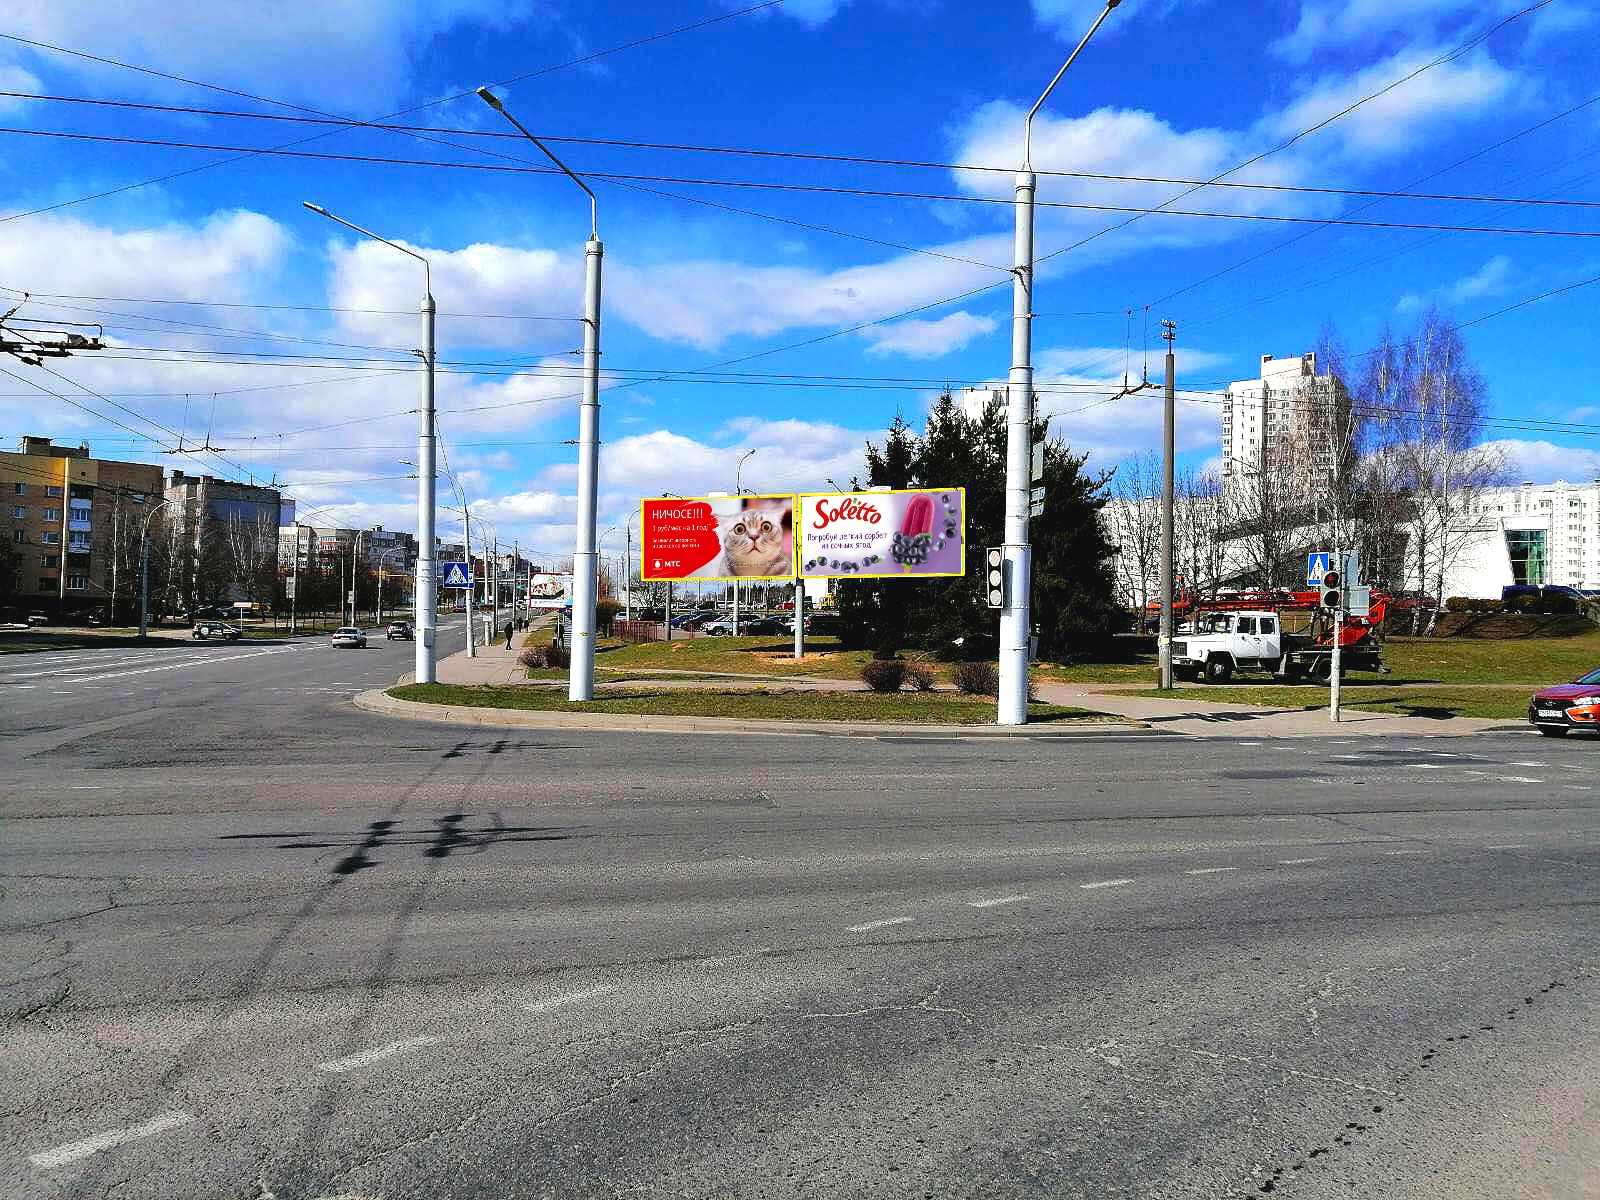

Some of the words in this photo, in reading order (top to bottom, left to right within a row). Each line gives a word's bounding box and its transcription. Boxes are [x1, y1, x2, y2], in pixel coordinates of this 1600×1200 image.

[652, 508, 703, 519] НИЧОСЕ!!!
[864, 531, 888, 542] сорбет
[664, 560, 681, 568] МТС
